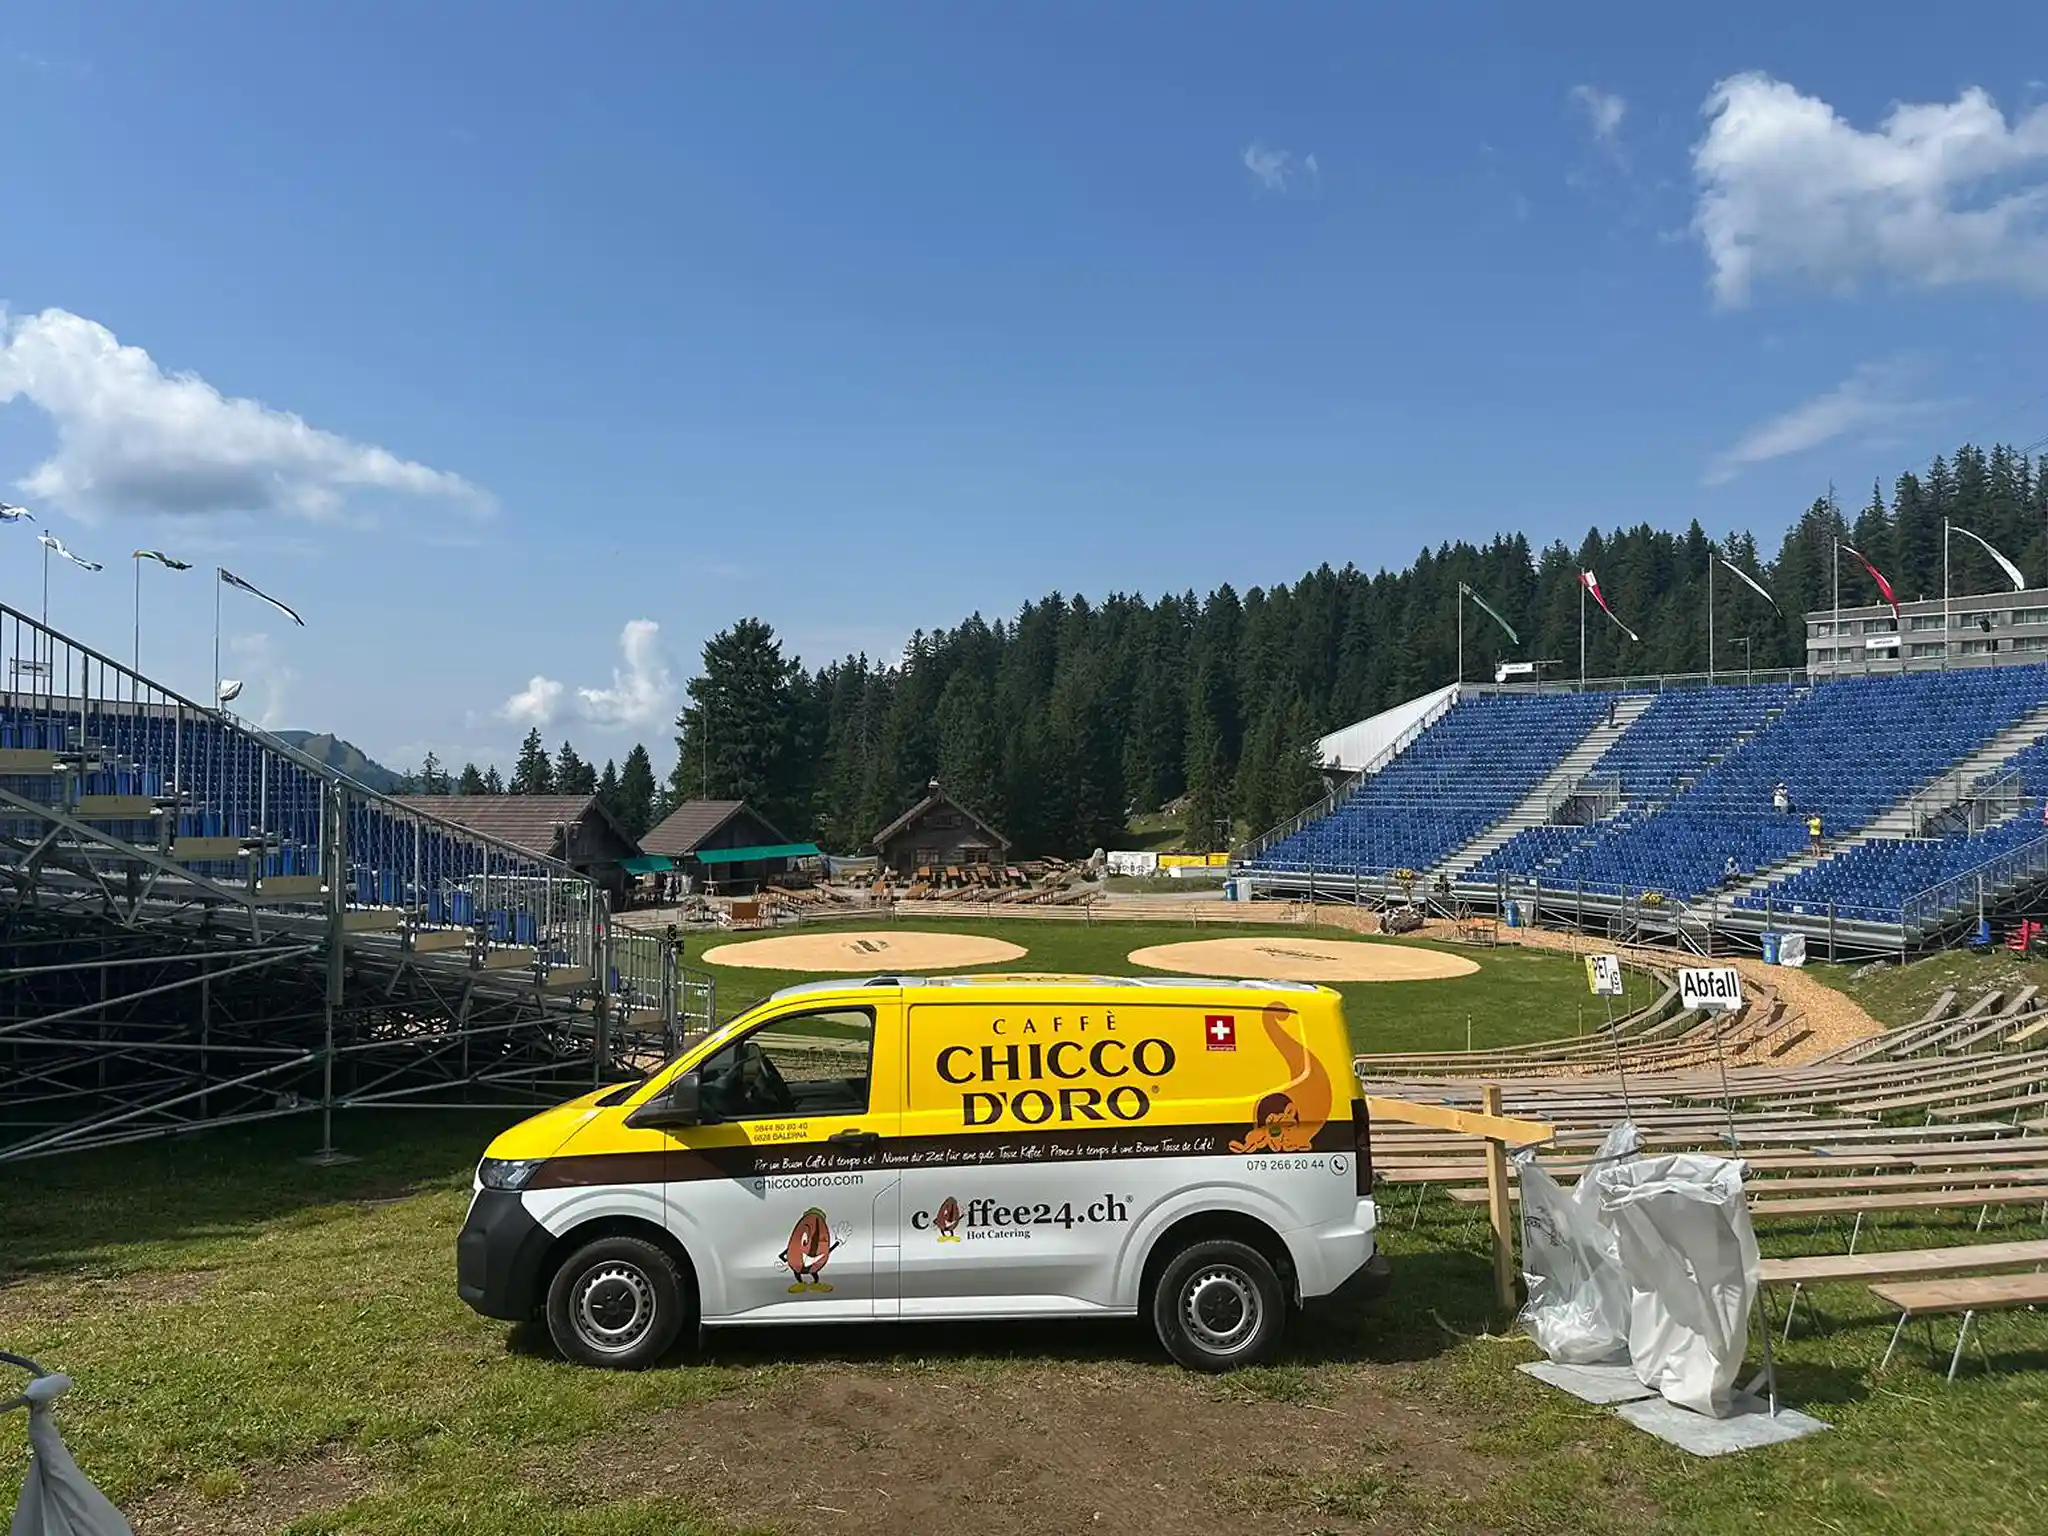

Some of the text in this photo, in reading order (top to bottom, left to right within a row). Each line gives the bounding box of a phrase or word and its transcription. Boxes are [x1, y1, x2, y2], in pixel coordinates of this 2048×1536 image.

[1684, 971, 1738, 998] Abfall
[993, 1010, 1116, 1035] CAFFÈ
[936, 1038, 1176, 1084] CHICCO
[962, 1085, 1150, 1126] D'ORO
[782, 1158, 803, 1169] Buon
[925, 1151, 945, 1162] Zeit
[945, 1148, 960, 1163] für
[998, 1145, 1019, 1159] Tasse
[1086, 1145, 1109, 1159] temps
[1136, 1141, 1159, 1153] Bonne
[1161, 1138, 1181, 1152] Tasse
[1182, 1141, 1193, 1151] de
[1246, 1159, 1324, 1171] 079 266 20 44
[754, 1174, 864, 1190] chiccodoro.com
[967, 1228, 1031, 1240] Hot Catering
